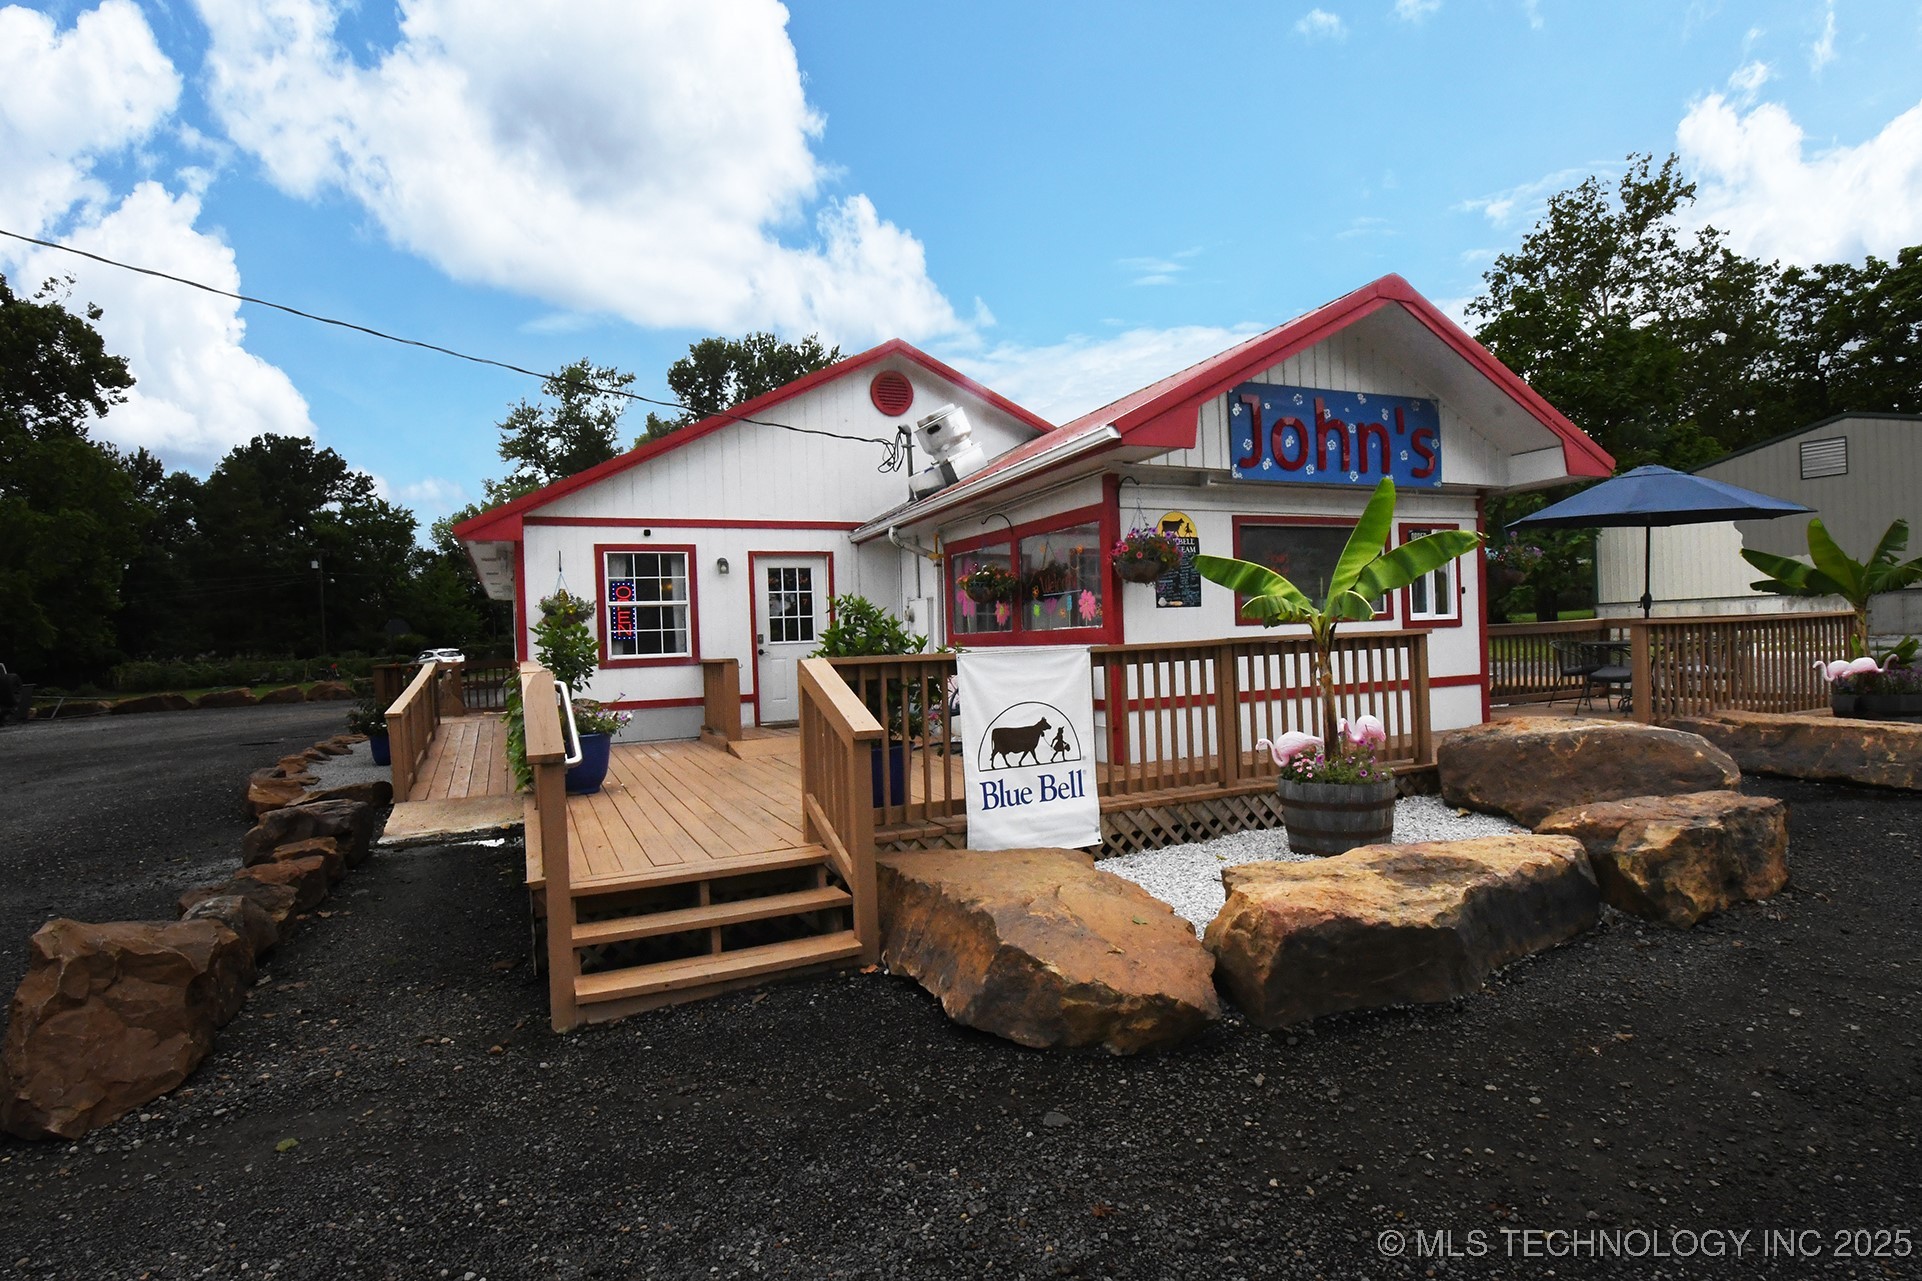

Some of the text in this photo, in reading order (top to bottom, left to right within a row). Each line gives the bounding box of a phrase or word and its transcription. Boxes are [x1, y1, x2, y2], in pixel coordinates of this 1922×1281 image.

[1238, 393, 1436, 479] John's
[979, 769, 1086, 811] Blue Bell
